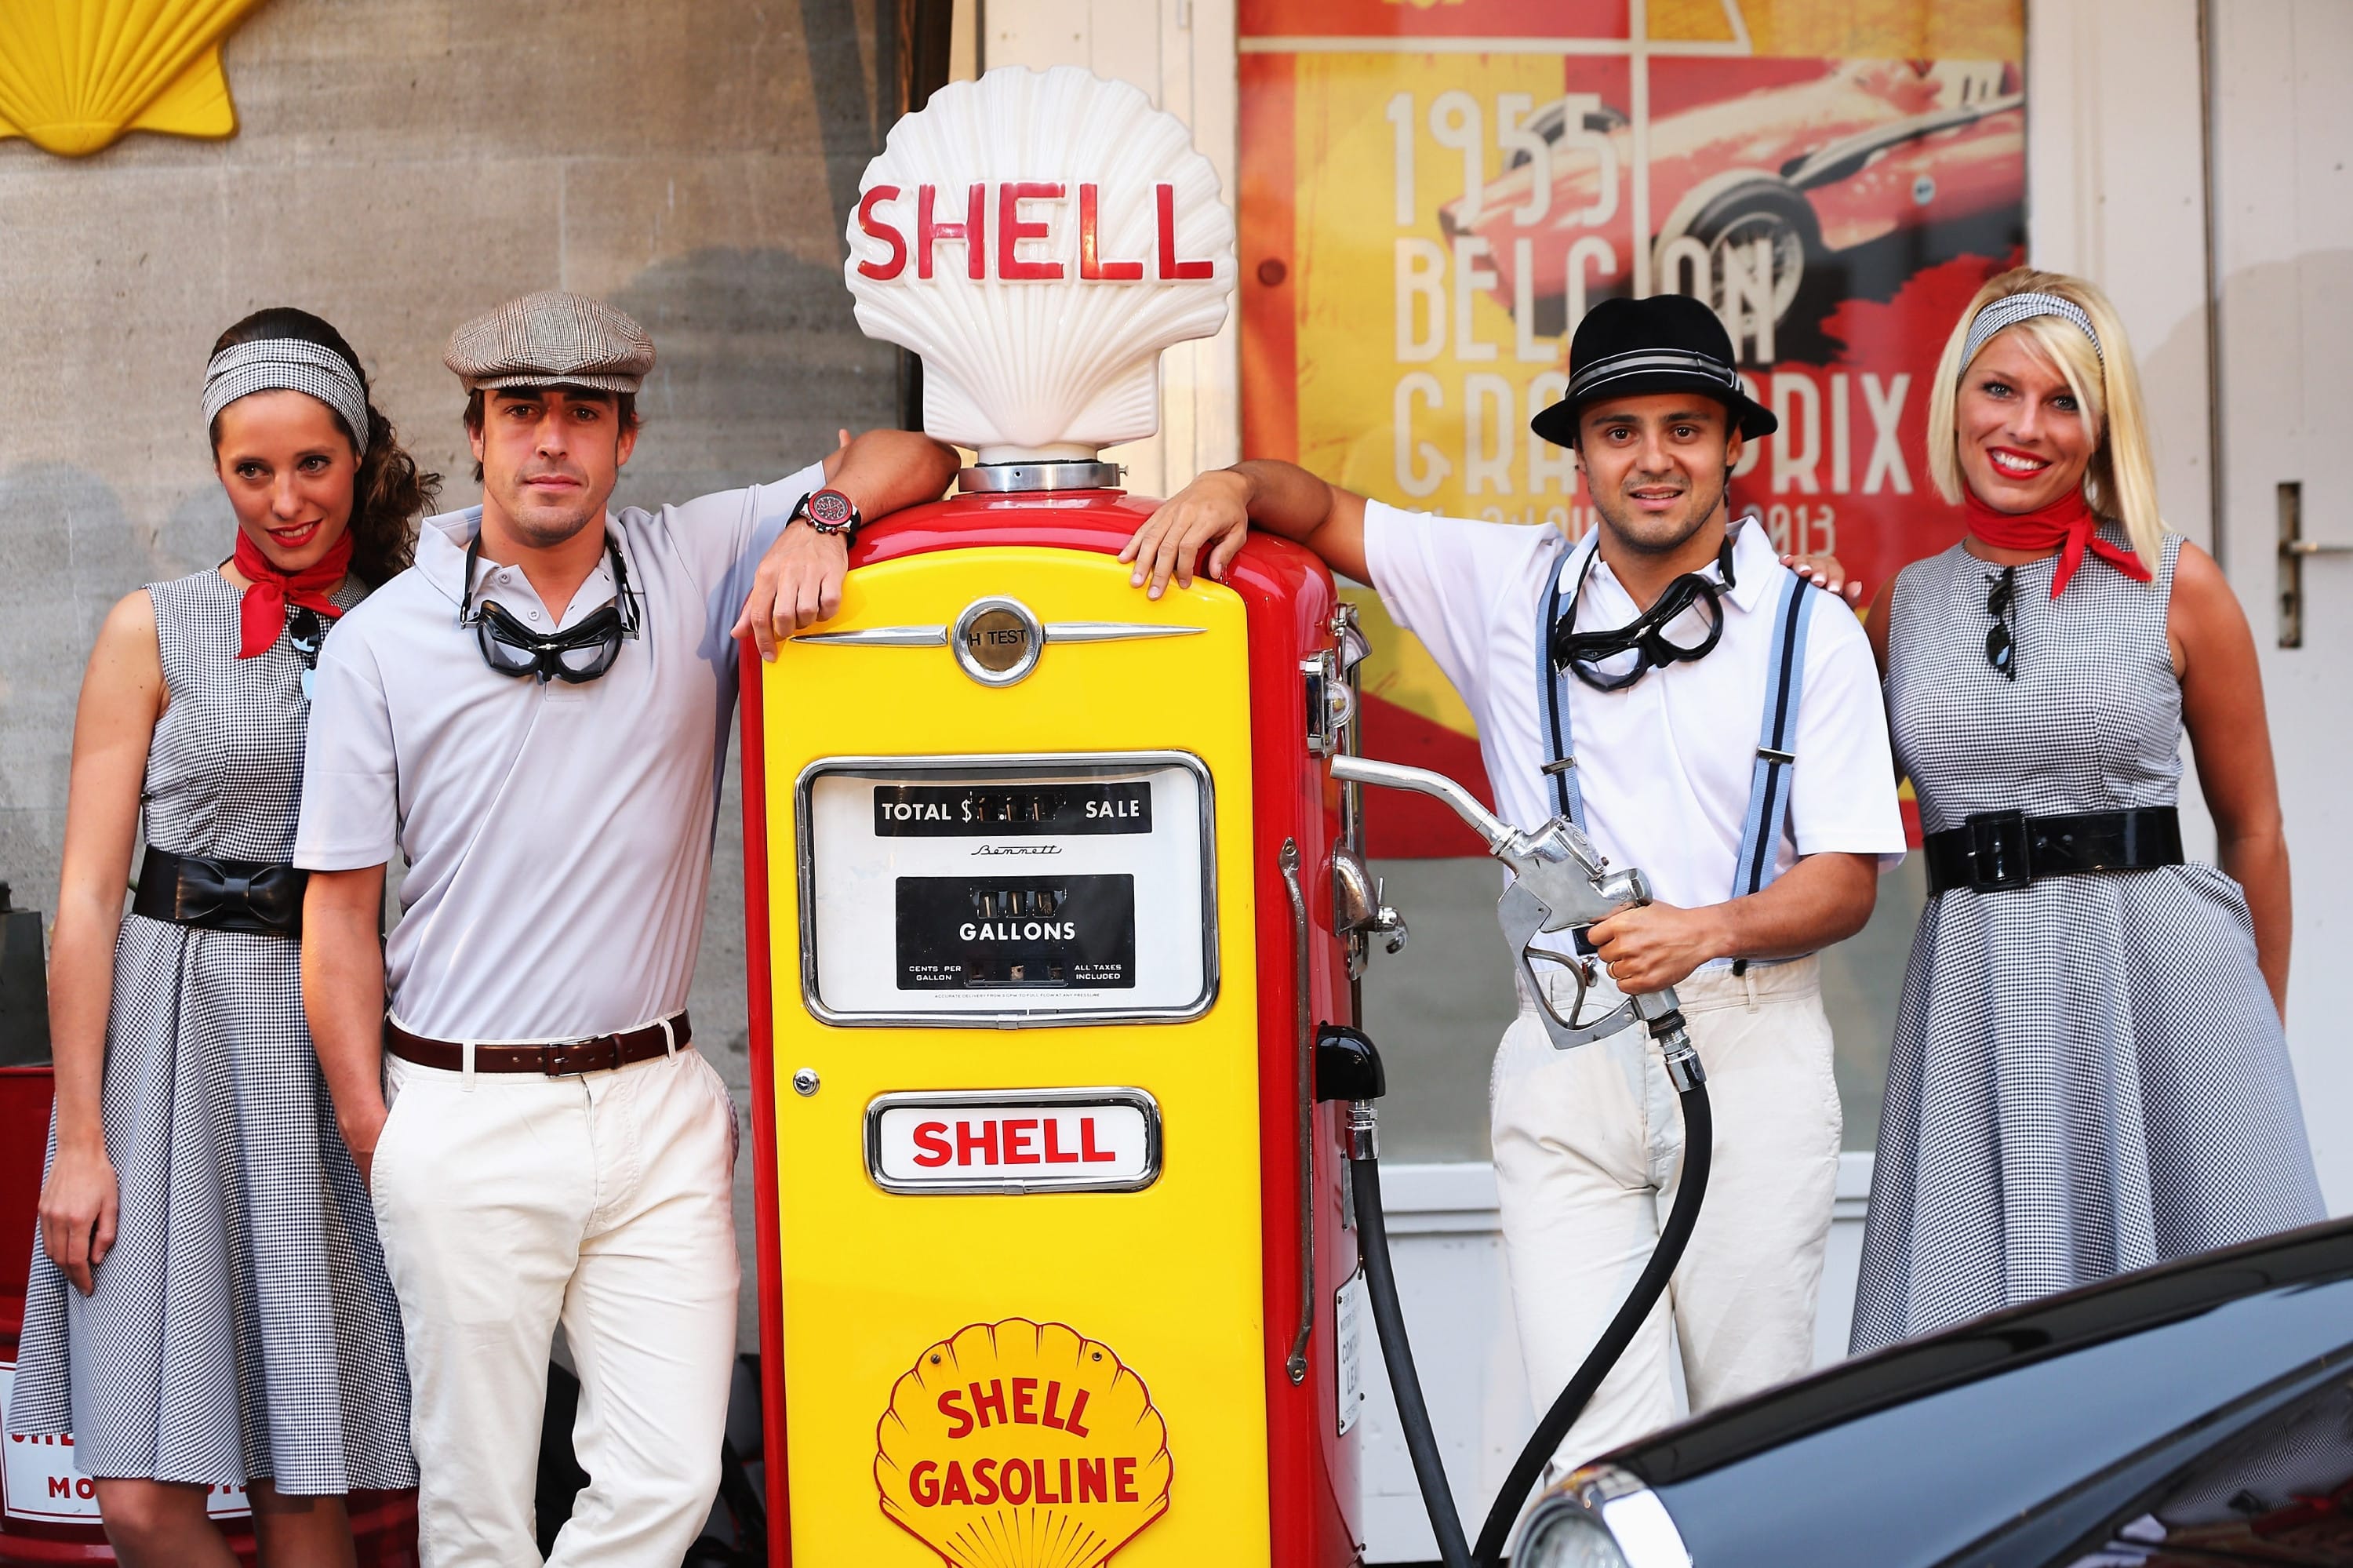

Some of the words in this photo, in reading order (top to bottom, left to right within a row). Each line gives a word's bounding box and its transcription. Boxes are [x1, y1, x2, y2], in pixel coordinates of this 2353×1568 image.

[1385, 90, 1619, 227] 1955
[858, 183, 1213, 280] SHELL
[1394, 373, 1577, 497] GRA
[987, 629, 1026, 644] TEST
[882, 803, 951, 820] TOTAL
[961, 799, 972, 823] $
[1085, 799, 1140, 818] SALE
[971, 845, 1062, 856] Bennett
[959, 922, 1075, 940] GALLONS
[912, 1117, 1115, 1168] SHELL
[937, 1377, 1090, 1439] SHELL
[909, 1457, 1139, 1507] GASOLINE
